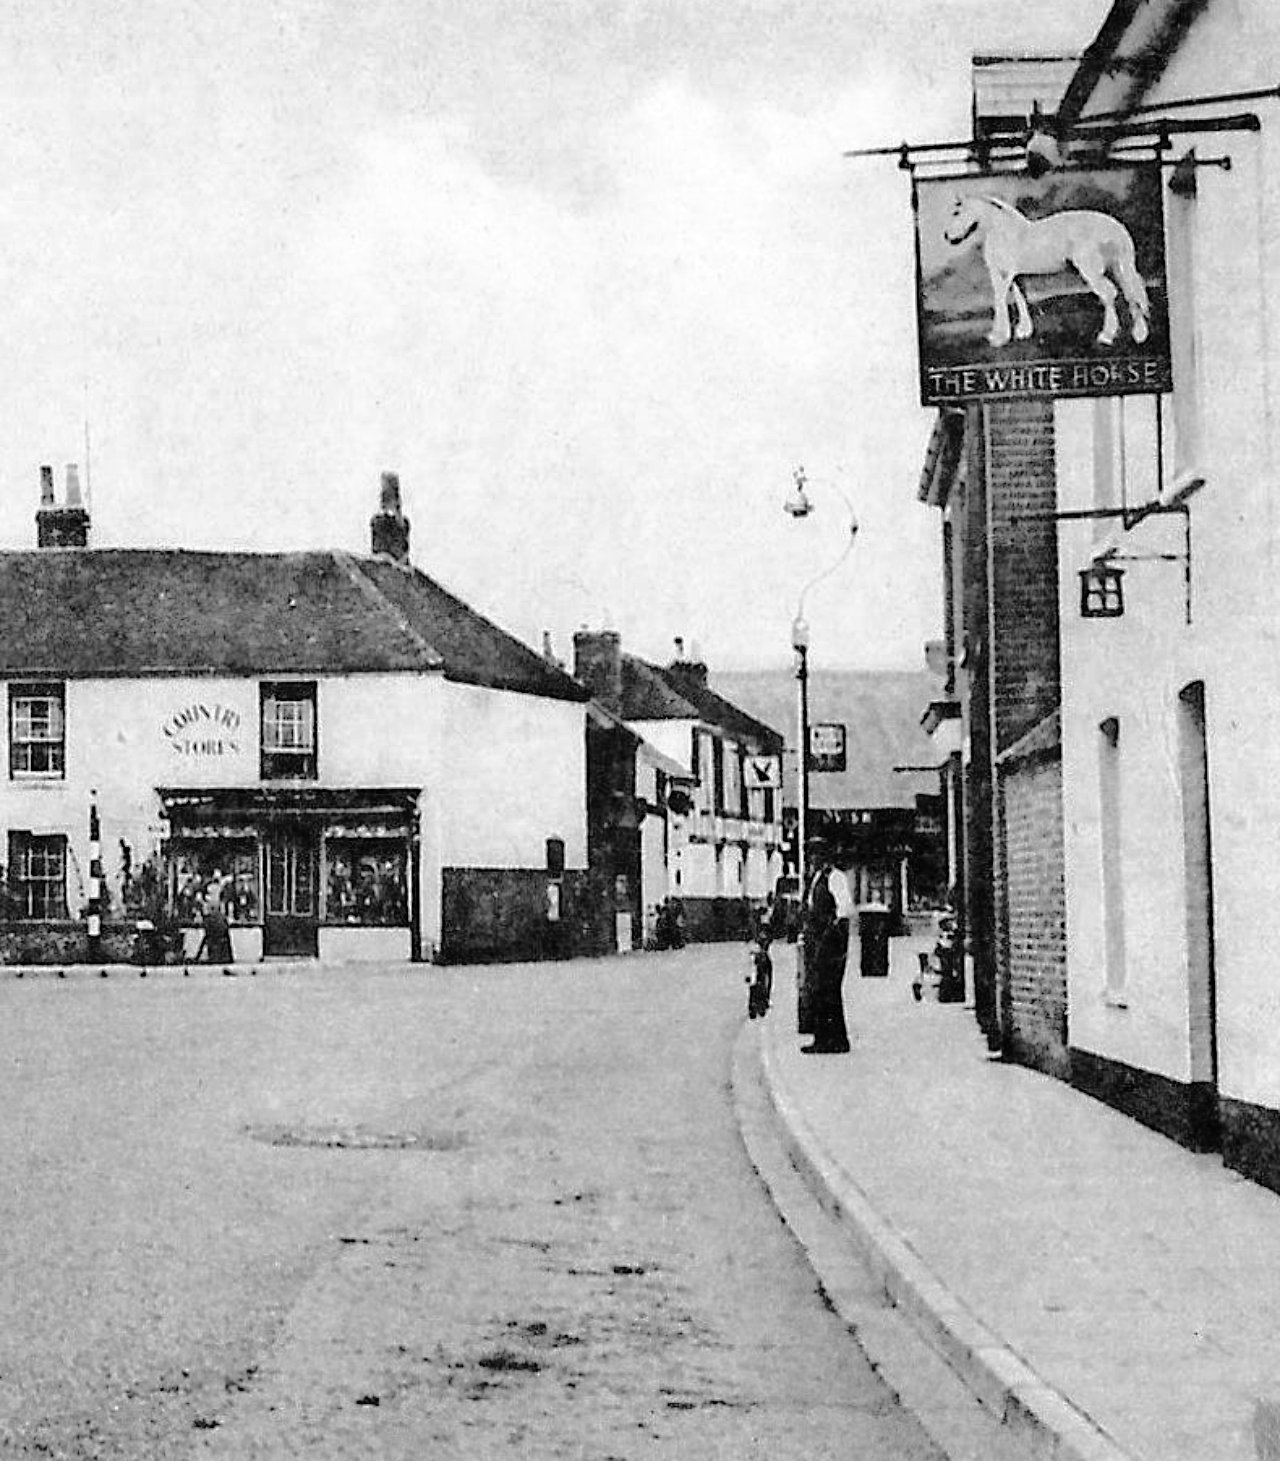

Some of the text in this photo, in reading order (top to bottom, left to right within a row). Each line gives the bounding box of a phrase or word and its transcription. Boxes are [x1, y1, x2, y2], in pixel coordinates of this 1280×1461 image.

[929, 361, 1158, 394] THE WHITE HORSE
[162, 705, 242, 737] COUNTRY
[172, 739, 241, 756] STORES
